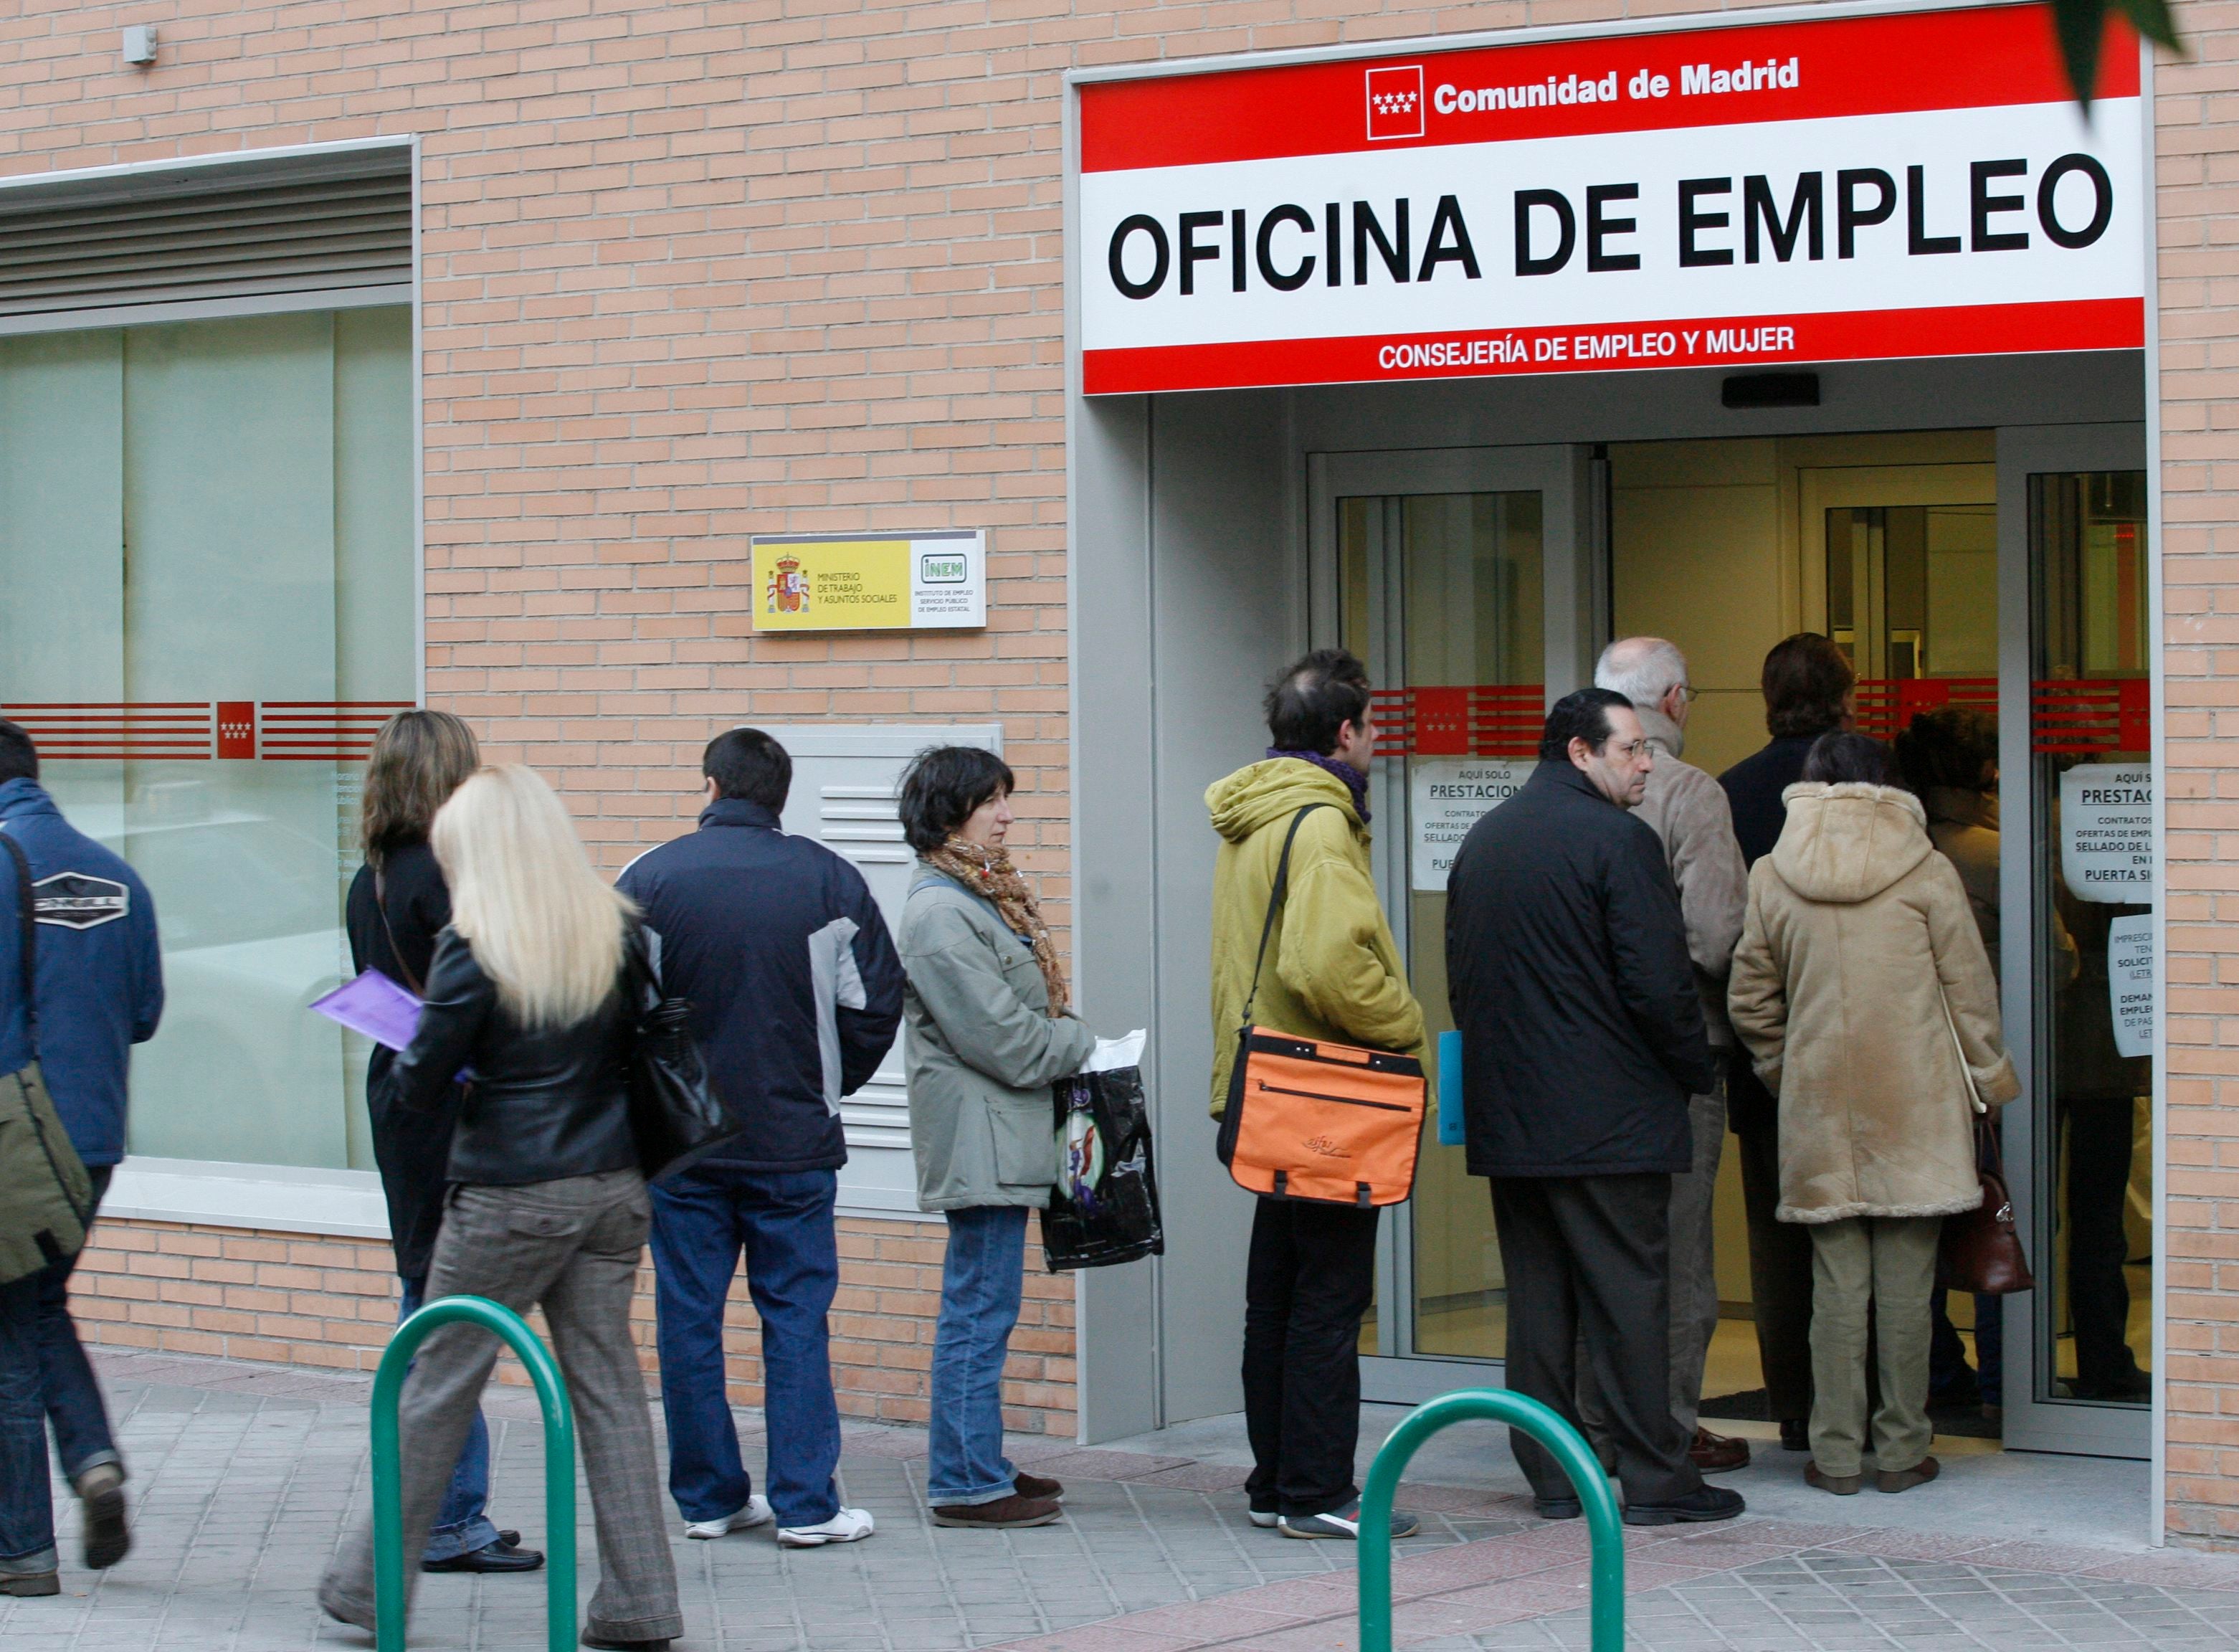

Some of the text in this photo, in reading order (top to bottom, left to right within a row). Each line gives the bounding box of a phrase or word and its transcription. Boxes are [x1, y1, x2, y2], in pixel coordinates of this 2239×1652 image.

[1435, 57, 1798, 113] Comunidad de Madrid
[1109, 153, 2112, 299] OFICINA DE EMPLEO
[1378, 327, 1794, 369] CONSEJERÍA DE EMPLEO Y MUJER
[829, 584, 862, 594] TRABAJO
[861, 594, 898, 603] SOCIALES
[1458, 769, 1511, 780] AQUÍ SOLO
[2115, 771, 2143, 784] AQUÍ
[2076, 842, 2125, 851] SELLADO
[2128, 842, 2142, 851] DE
[2132, 855, 2147, 864] EN
[2085, 870, 2152, 880] PUERTA SI
[2120, 1005, 2152, 1015] EMPLE
[2124, 1018, 2136, 1027] DE
